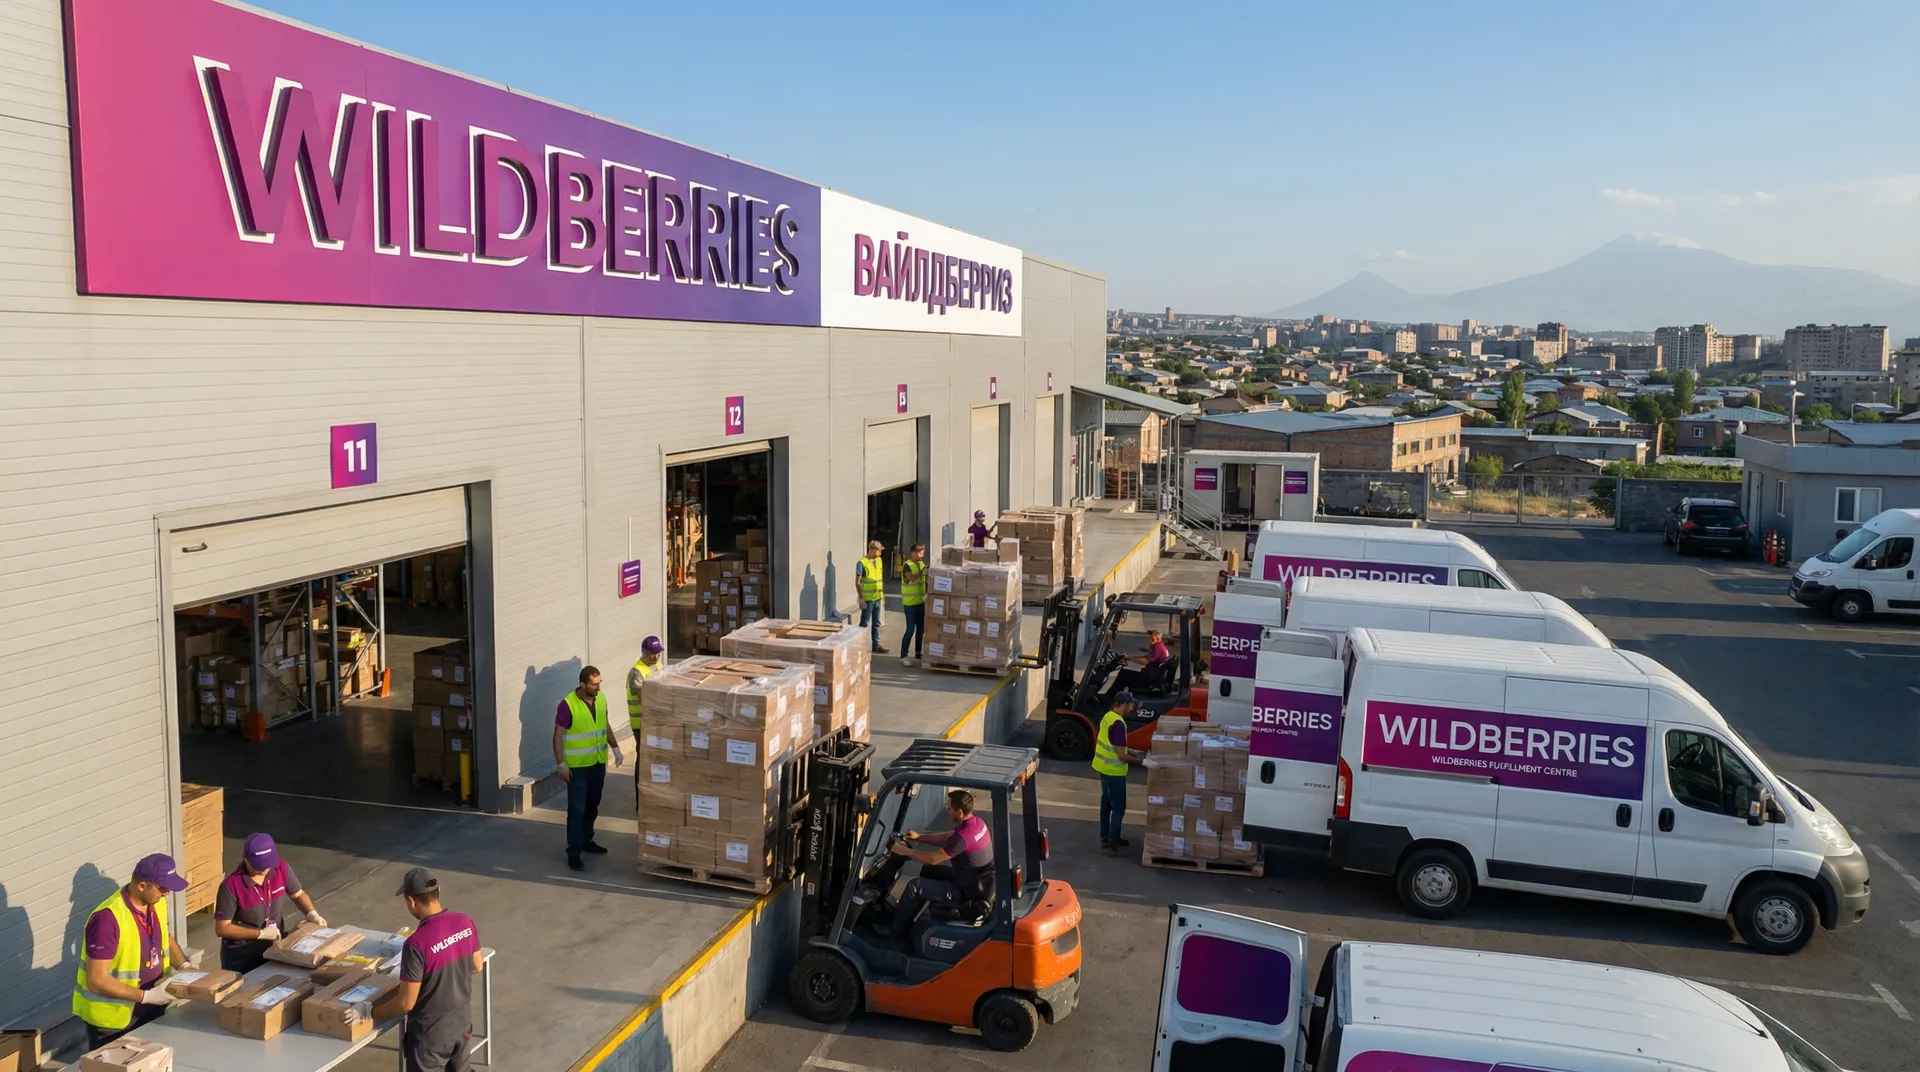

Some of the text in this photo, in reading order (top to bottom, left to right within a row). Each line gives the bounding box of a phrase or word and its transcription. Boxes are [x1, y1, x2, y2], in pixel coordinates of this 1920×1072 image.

[191, 54, 801, 296] WILDBERRIES
[853, 230, 1014, 316] ВАЙЛДБЕРРИЗ
[729, 405, 742, 426] 12
[343, 439, 367, 473] 11
[1251, 705, 1333, 731] BERRIES
[1378, 713, 1635, 769] WILDBERRIES
[1431, 755, 1488, 769] WILDBERRIES
[1543, 766, 1578, 778] CENTRE
